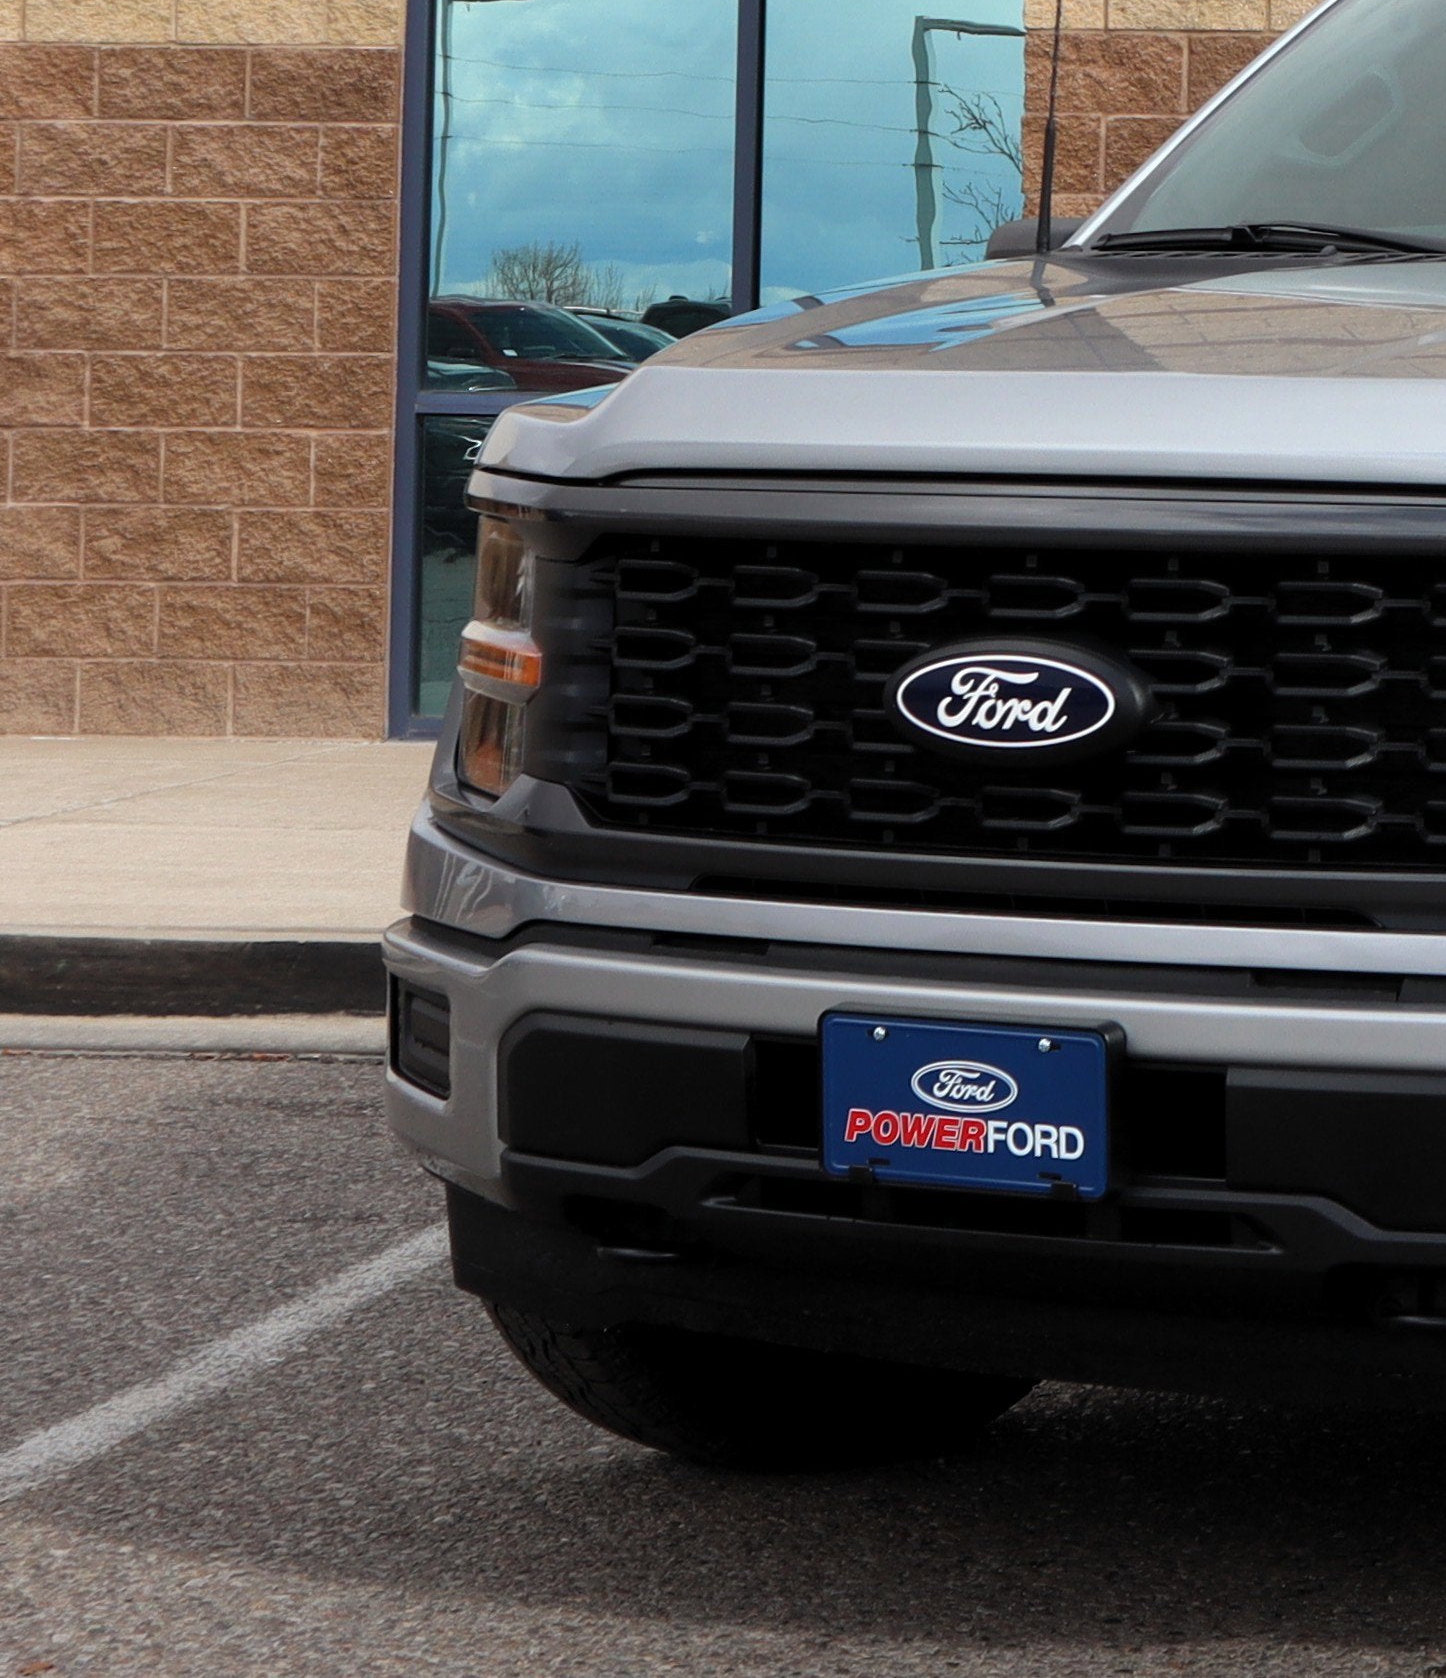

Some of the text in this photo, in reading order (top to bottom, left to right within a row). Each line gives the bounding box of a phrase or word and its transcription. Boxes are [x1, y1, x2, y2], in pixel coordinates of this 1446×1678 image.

[936, 666, 1072, 733] Ford
[933, 1069, 997, 1103] Ford
[844, 1107, 1085, 1160] POWERFORD
